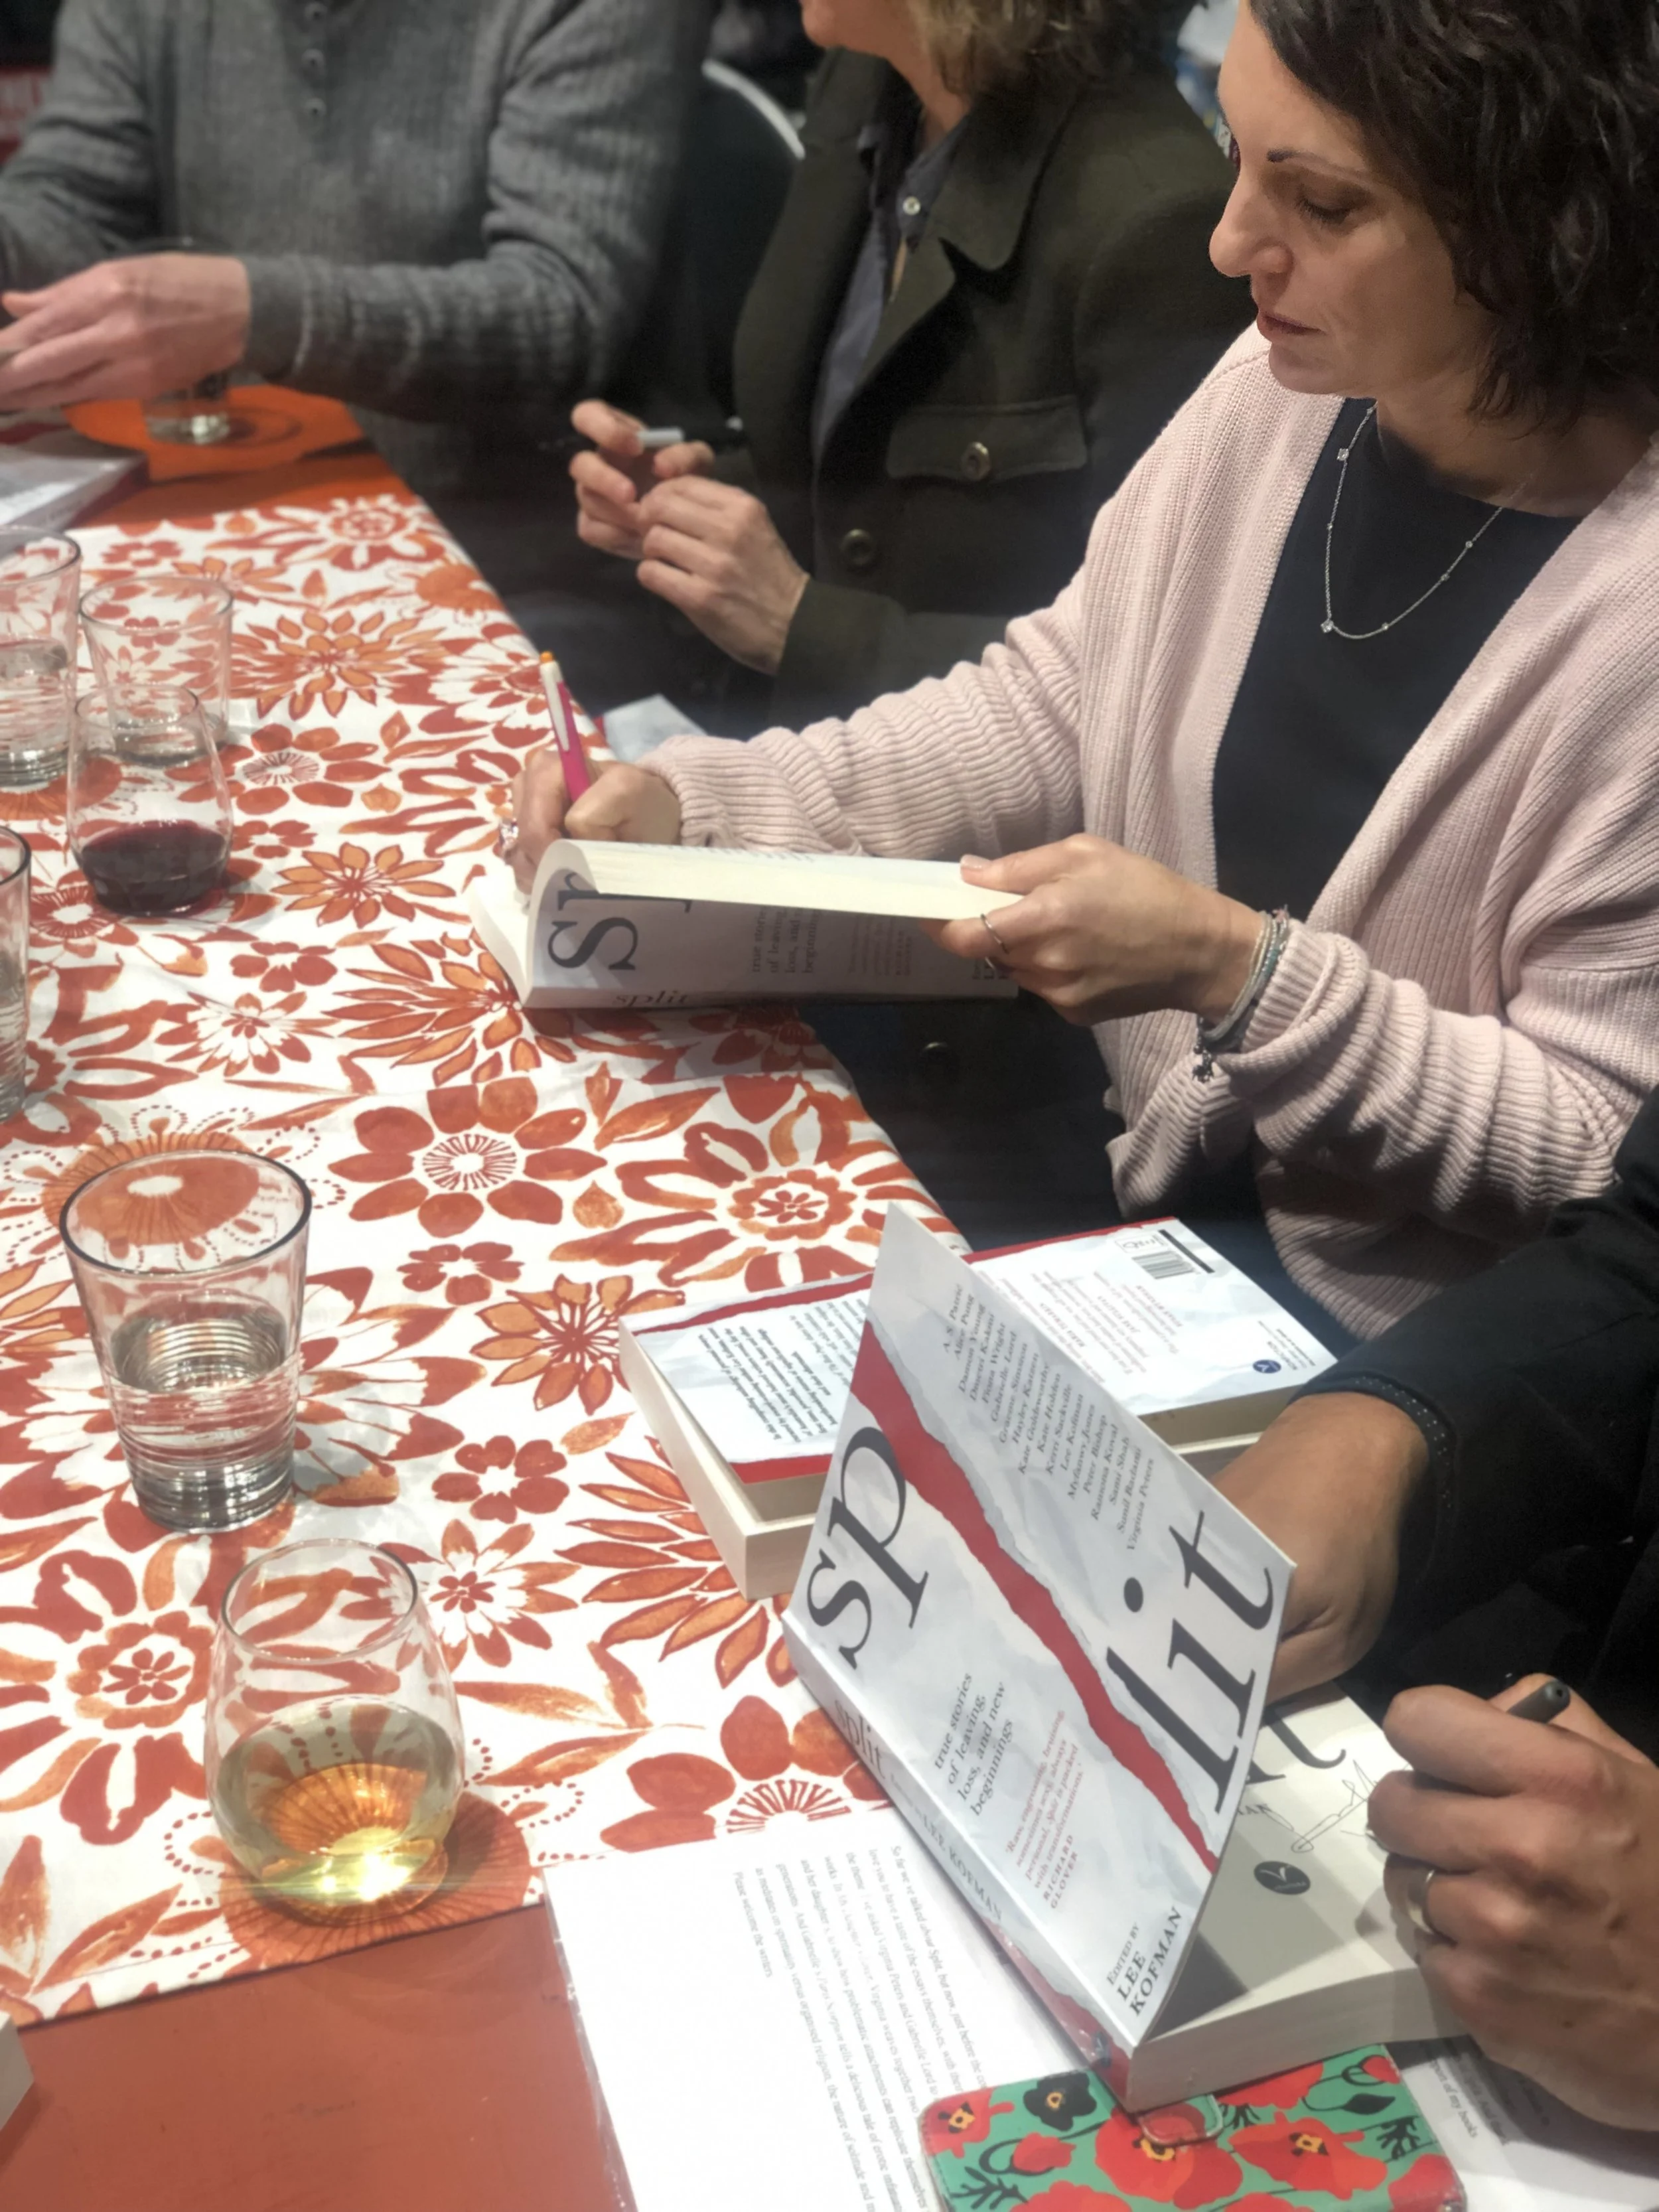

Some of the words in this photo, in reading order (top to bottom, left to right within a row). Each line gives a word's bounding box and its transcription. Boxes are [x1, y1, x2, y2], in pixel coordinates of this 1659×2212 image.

[954, 1328, 966, 1360] Alice
[960, 1293, 974, 1325] Pung
[960, 1347, 974, 1394] Damon
[970, 1303, 985, 1343] Young
[982, 1370, 995, 1404] Fiona
[990, 1323, 1005, 1364] Wright
[990, 1366, 1009, 1422] Gabrielle
[1003, 1331, 1017, 1363] Lord
[1037, 1423, 1049, 1453] Kate
[1044, 1373, 1060, 1420] Holden
[999, 1395, 1015, 1443] Graeme
[1012, 1401, 1028, 1444] Hayley
[1017, 1445, 1031, 1474] Kate
[1027, 1362, 1049, 1441] Goldsworthy
[1045, 1440, 1059, 1475] Kerri
[1054, 1384, 1072, 1438] Sackville
[1060, 1448, 1071, 1471] Lee
[1066, 1394, 1083, 1445] Kofman
[1068, 1443, 1086, 1499] Myfanwy
[1082, 1404, 1094, 1443] Jones
[1082, 1461, 1096, 1494] Peter
[1090, 1415, 1107, 1457] Bishop
[1091, 1466, 1109, 1520] Ramona
[1103, 1424, 1118, 1463] Koval
[1108, 1471, 1121, 1505] Sami
[1116, 1436, 1130, 1469] Shah
[1116, 1498, 1130, 1534] Sunil
[1124, 1445, 1141, 1497] Badami
[1126, 1501, 1145, 1550] Virginia
[1139, 1458, 1153, 1497] Peters
[806, 1426, 929, 1670] sp
[1106, 1511, 1275, 1814] lit
[835, 1700, 886, 1783] split
[934, 1732, 952, 1769] true
[950, 1673, 972, 1730] stories
[948, 1759, 959, 1785] of
[954, 1696, 985, 1759] leaving,
[957, 1767, 981, 1807] loss,
[977, 1721, 991, 1759] and
[989, 1682, 1004, 1720] new
[970, 1720, 1012, 1815] beginnings
[1016, 1808, 1043, 1867] sometimes
[1050, 1739, 1066, 1777] always
[1060, 1743, 1078, 1789] packed
[949, 1846, 1001, 1925] KOFMAN
[1034, 1864, 1048, 1888] with
[1043, 1835, 1072, 1900] RICHARD
[1050, 1852, 1077, 1908] GLOVER
[733, 1872, 747, 1896] Please
[742, 1898, 758, 1931] welcome
[753, 1933, 763, 1946] the
[889, 1973, 904, 2000] Peters
[906, 1952, 917, 1966] the
[912, 1968, 927, 1996] essays
[1117, 1951, 1145, 2000] LEE
[1129, 1907, 1180, 2015] KOFMAN
[800, 2000, 822, 2043] organised
[827, 2084, 838, 2099] the
[843, 1989, 868, 2040] problematic
[863, 2043, 887, 2096] attachments
[899, 2002, 912, 2018] and
[905, 2020, 926, 2060] Gabrielle
[937, 1973, 950, 1988] but
[950, 2013, 965, 2029] just
[959, 2029, 975, 2057] before
[883, 2024, 898, 2055] weaves
[893, 2057, 912, 2093] together
[920, 2062, 936, 2084] Lord
[848, 2071, 867, 2112] delicious
[862, 2113, 875, 2130] tale
